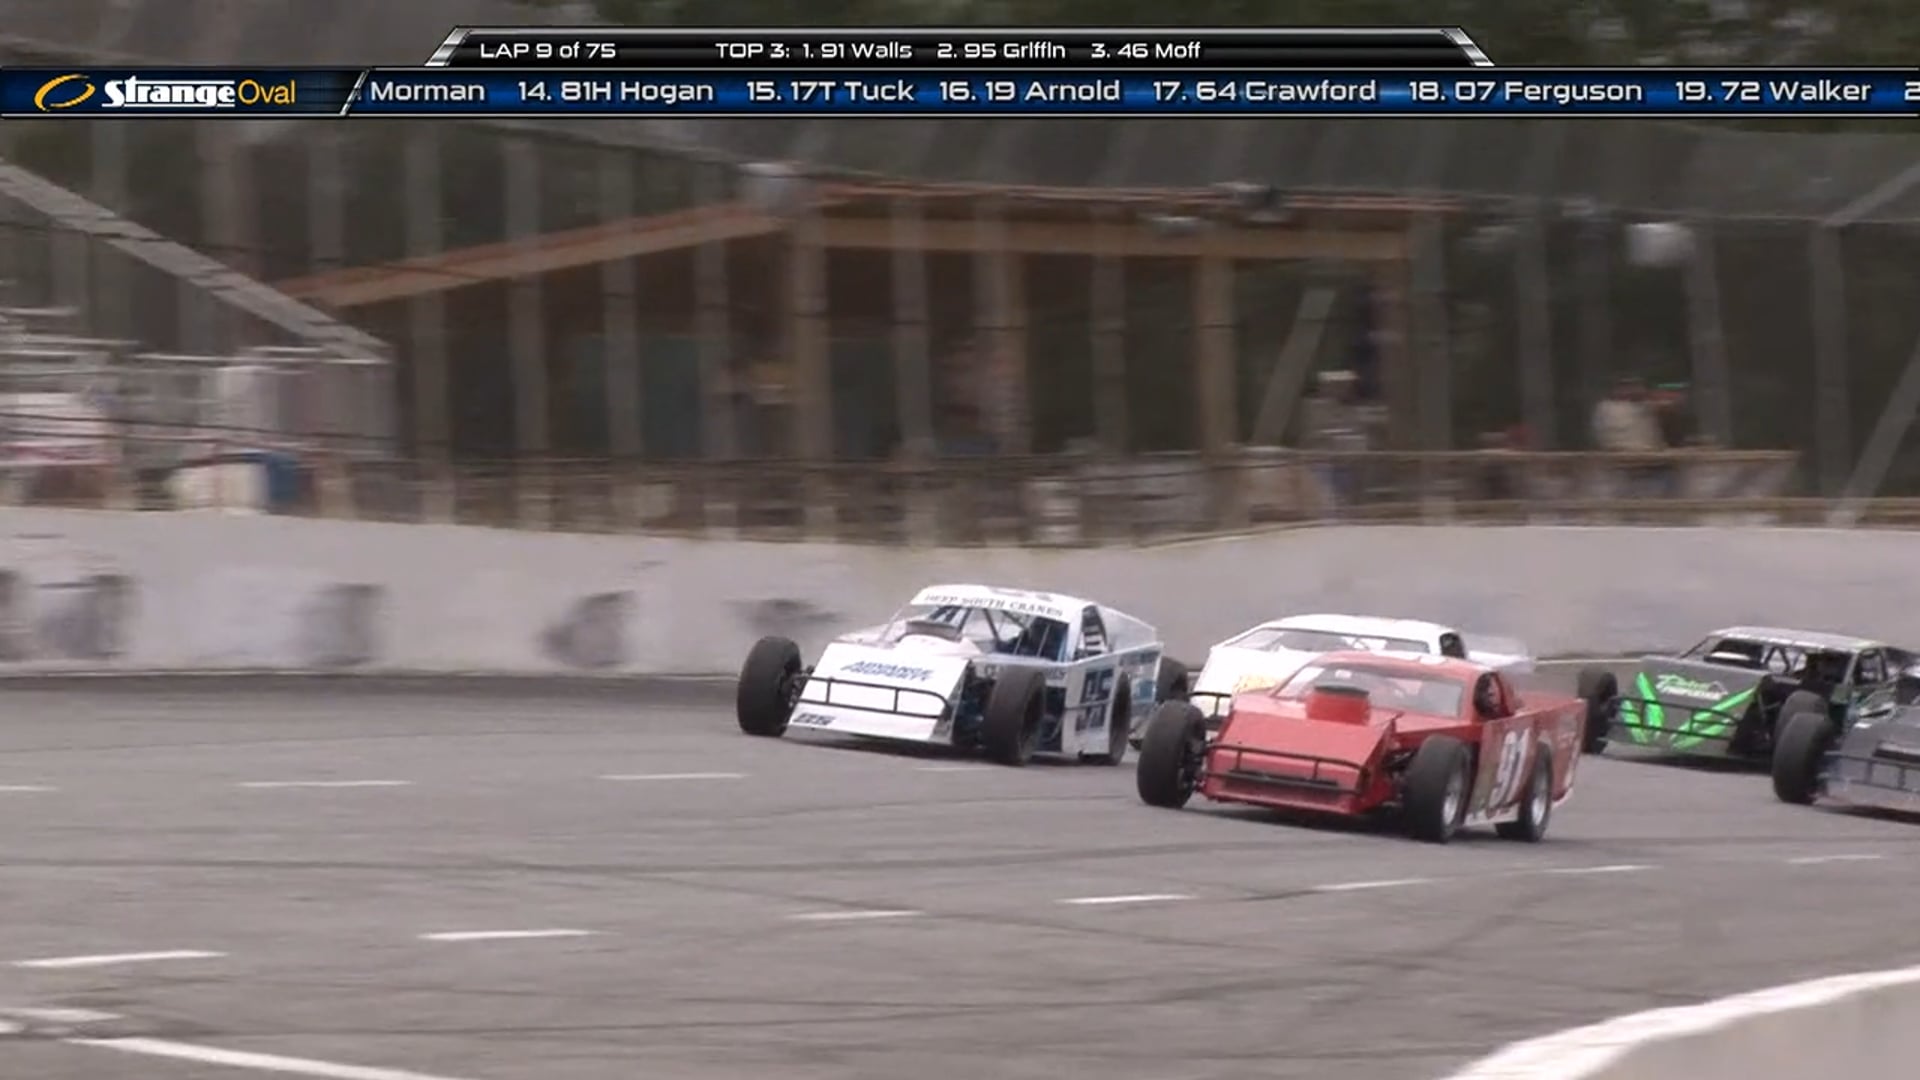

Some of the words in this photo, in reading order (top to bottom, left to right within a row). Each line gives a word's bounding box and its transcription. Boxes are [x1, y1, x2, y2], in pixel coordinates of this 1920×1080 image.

[960, 596, 1005, 609] SOUTH
[1009, 600, 1063, 617] CRANES
[1488, 726, 1530, 807] 91
